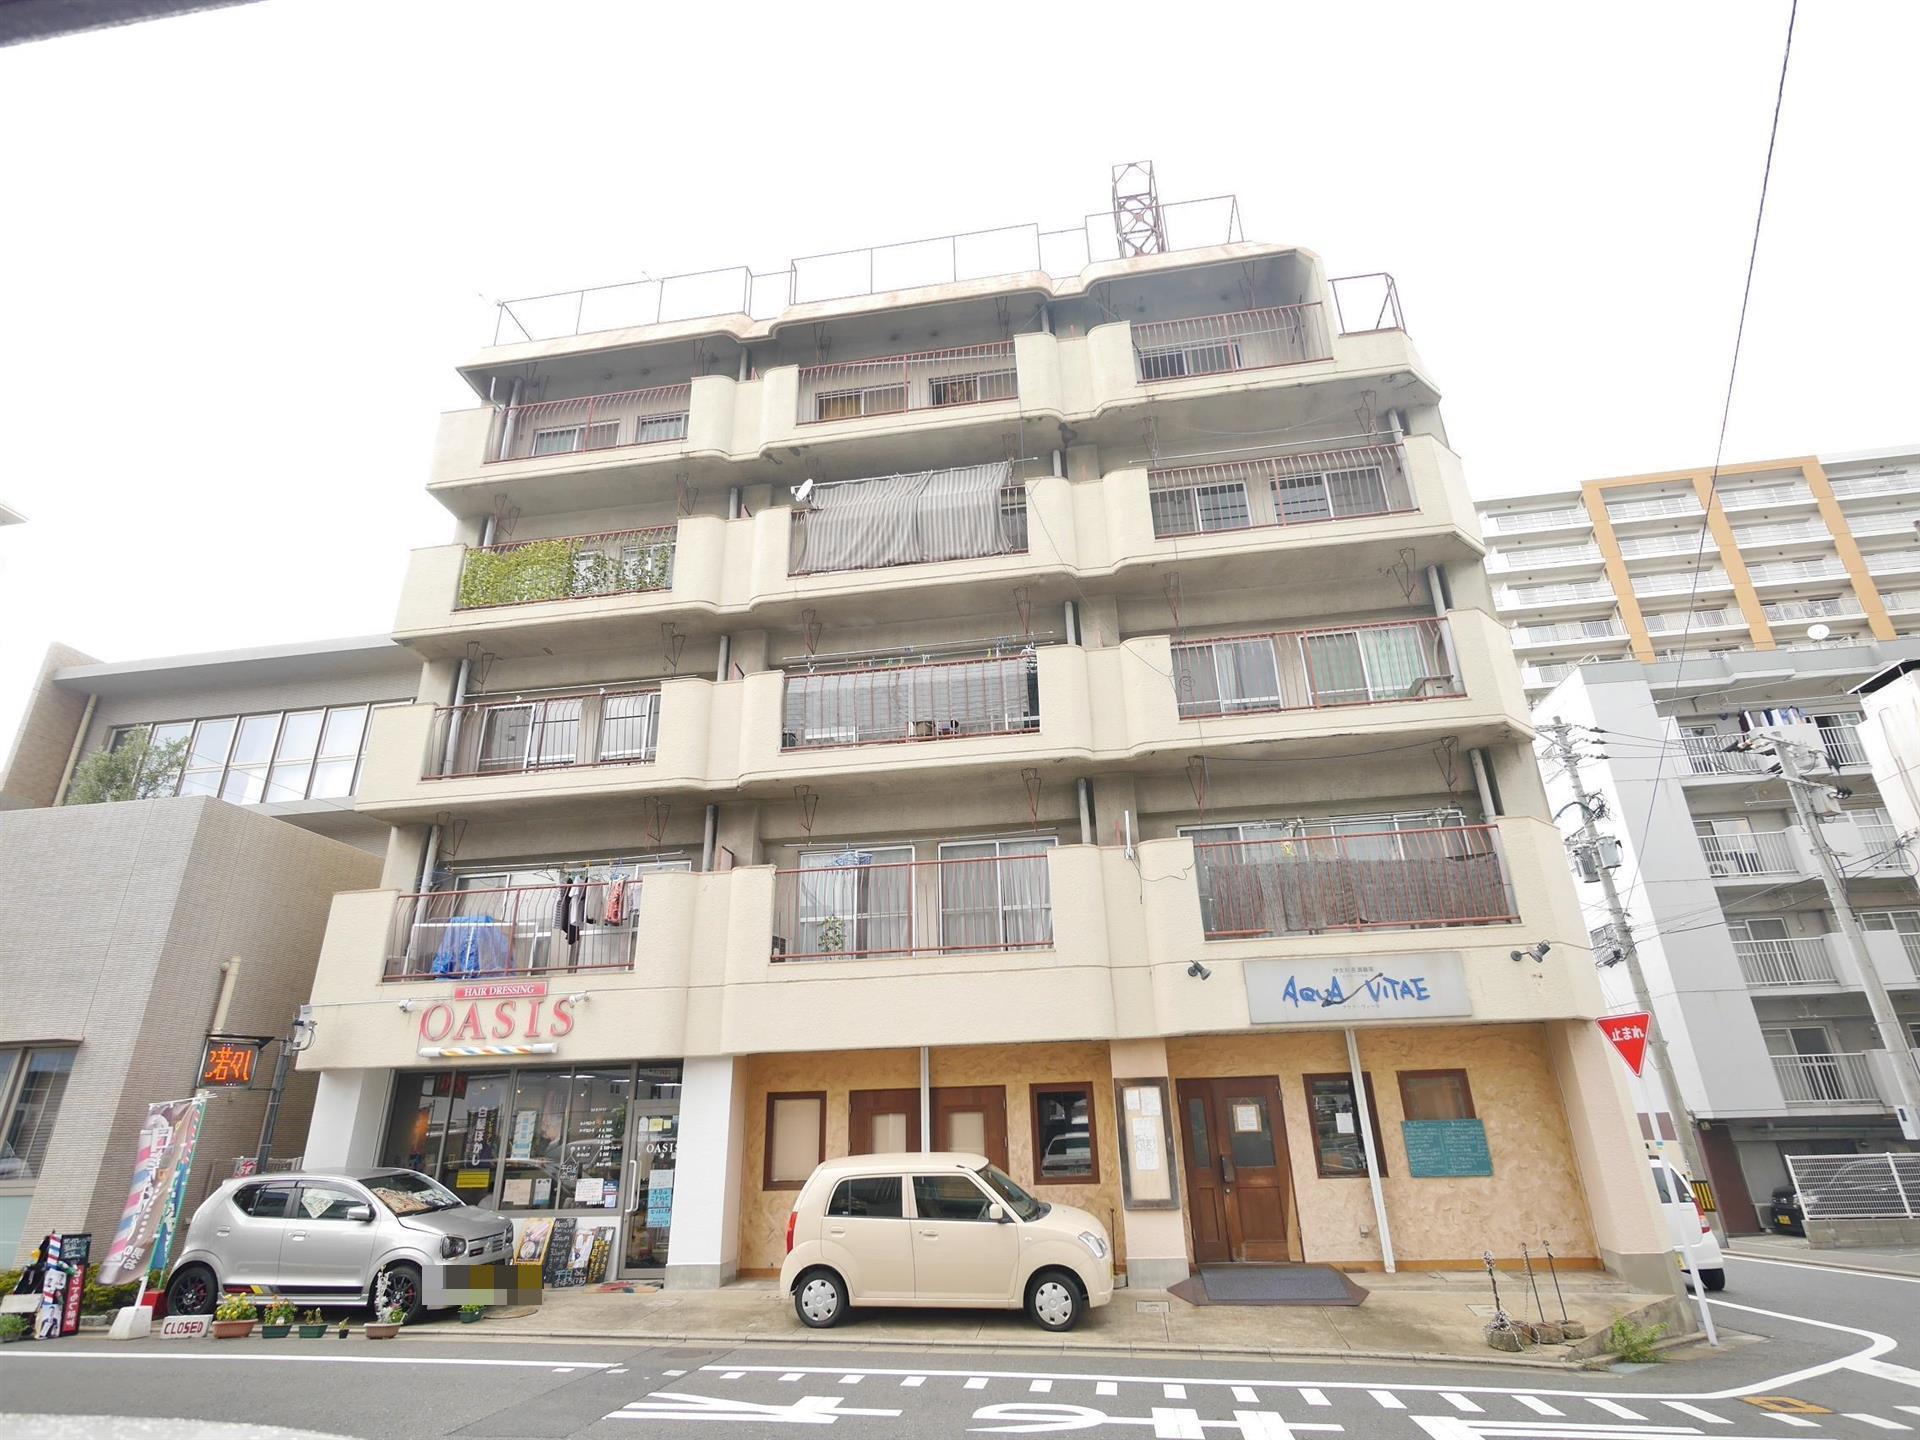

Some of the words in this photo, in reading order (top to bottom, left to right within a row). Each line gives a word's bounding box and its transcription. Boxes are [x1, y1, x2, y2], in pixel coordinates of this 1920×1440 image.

[464, 987, 487, 997] HAIR
[489, 984, 536, 995] DRESSING
[420, 999, 575, 1042] OASIS
[1611, 1025, 1645, 1042] 止まれ
[164, 1321, 204, 1335] CLOSED
